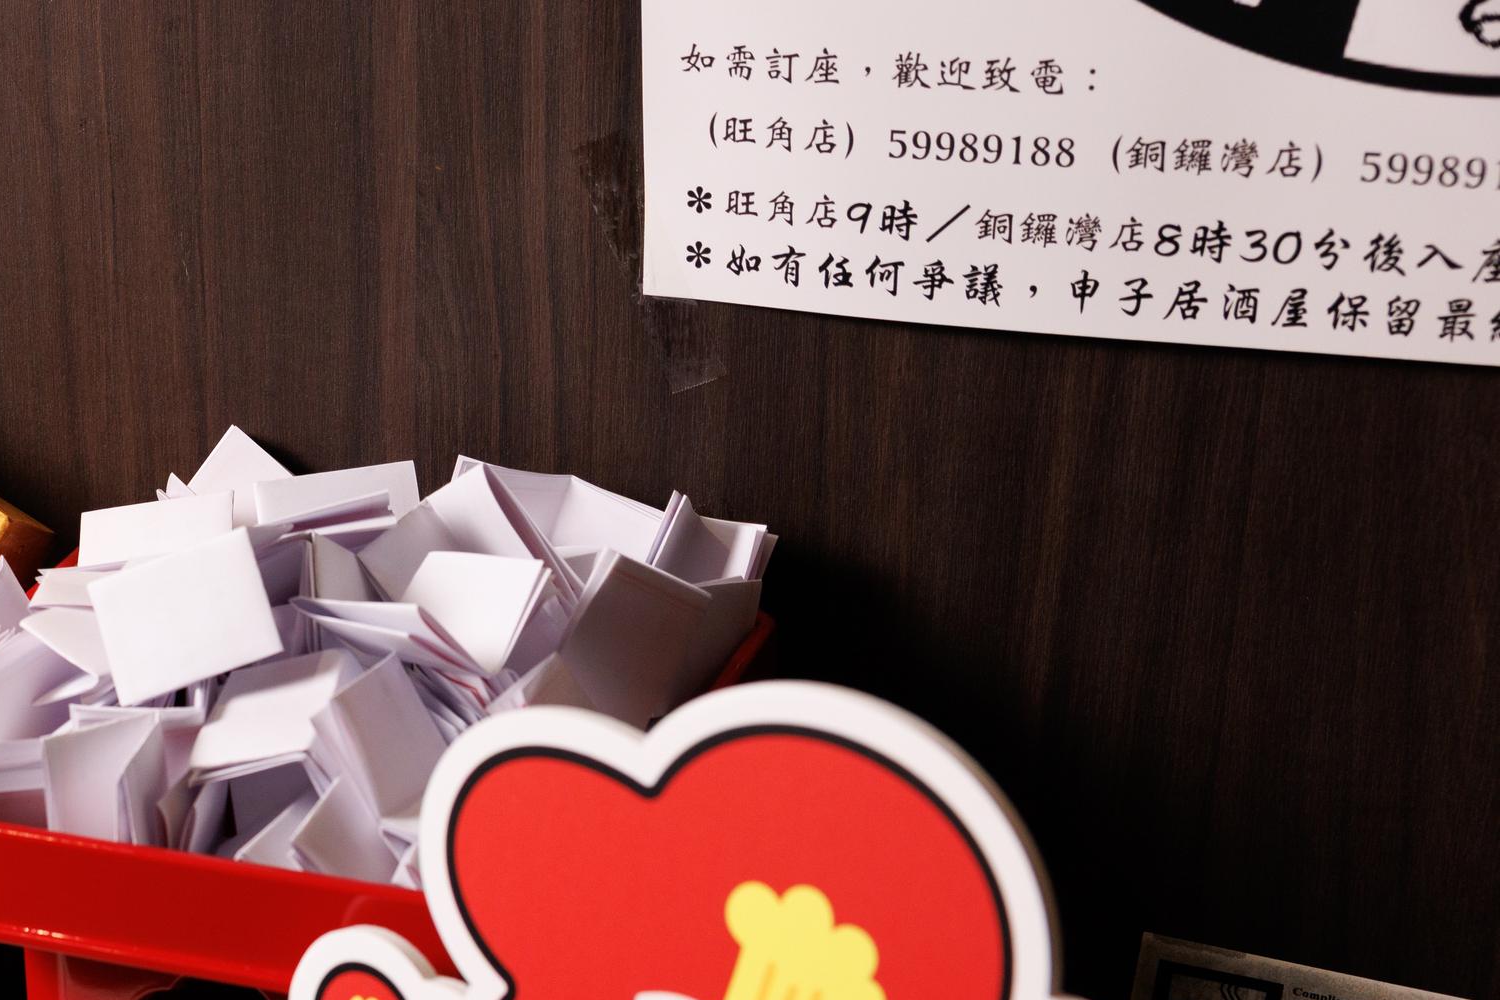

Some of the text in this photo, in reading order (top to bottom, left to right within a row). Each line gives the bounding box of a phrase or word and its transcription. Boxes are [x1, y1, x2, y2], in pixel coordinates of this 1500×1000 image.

[888, 129, 1076, 168] 59989188
[726, 243, 1500, 343] 如有任何爭議，申子居酒屋保留最
